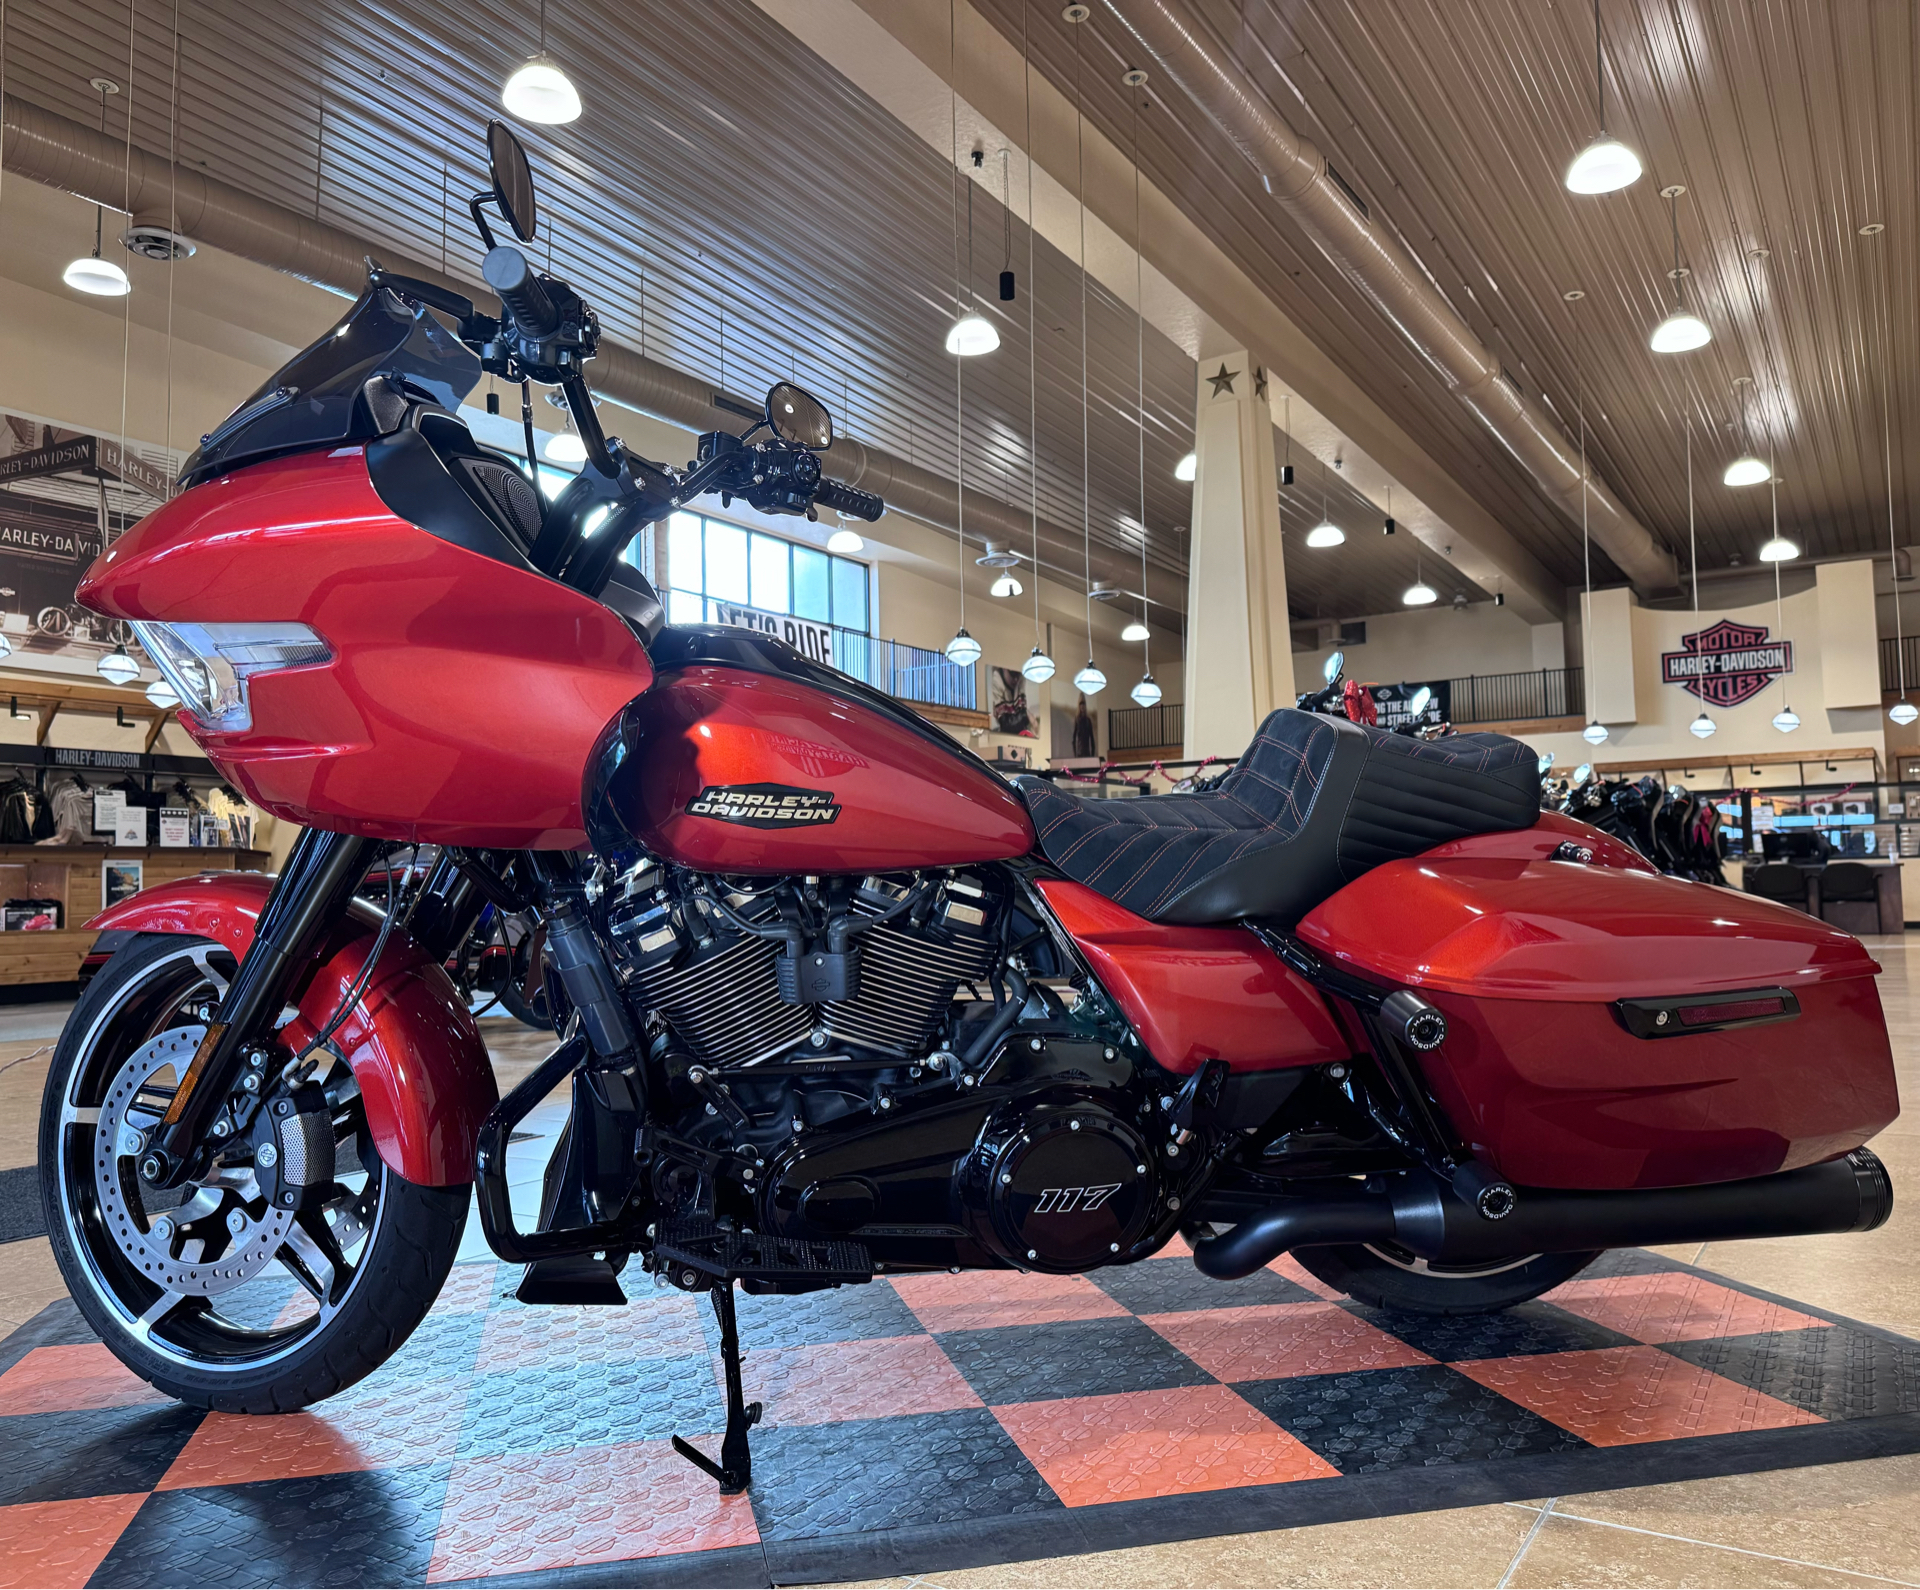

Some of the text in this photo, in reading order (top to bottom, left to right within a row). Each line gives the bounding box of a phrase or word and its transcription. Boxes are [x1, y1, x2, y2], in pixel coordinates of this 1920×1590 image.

[0, 444, 90, 476] RLEY-DAVIDSON
[0, 527, 101, 557] ARLEY-DAVID
[1695, 628, 1756, 650] MOTOR
[1670, 649, 1784, 677] HARLEY-DAVIDSON
[1696, 675, 1758, 700] CYCLES
[55, 749, 140, 768] HARLEY-DAVIDSON
[691, 803, 834, 820] DAVIDSON
[1413, 1014, 1444, 1027] HARLEY
[1411, 1034, 1444, 1049] DAVIDSON
[1034, 1183, 1122, 1213] 117
[1485, 1187, 1513, 1199] HARLEY
[1482, 1204, 1513, 1219] DAVIDSON
